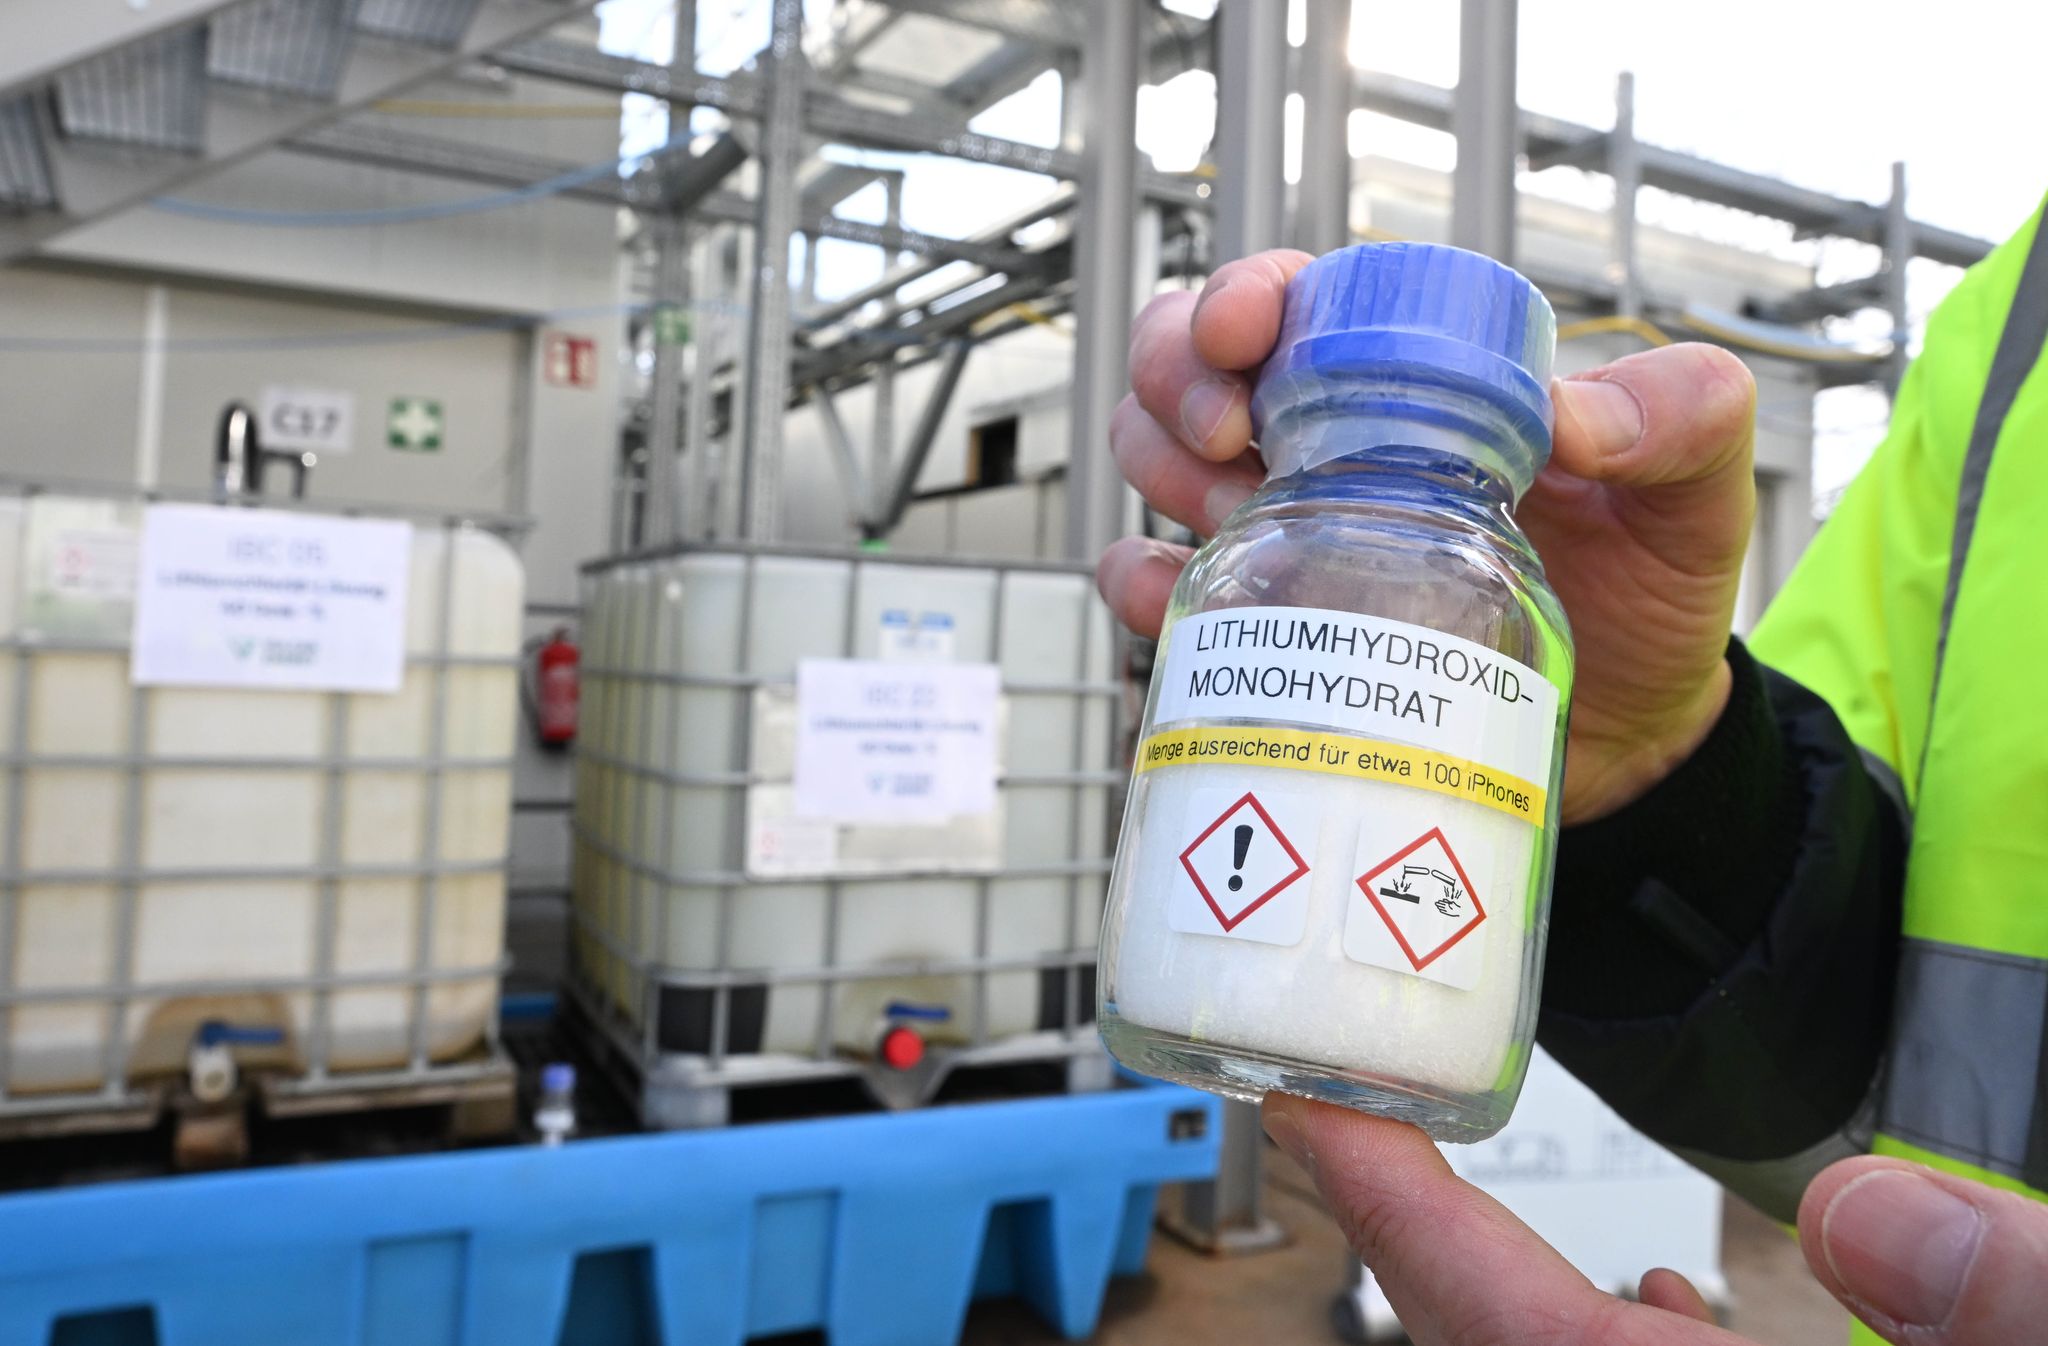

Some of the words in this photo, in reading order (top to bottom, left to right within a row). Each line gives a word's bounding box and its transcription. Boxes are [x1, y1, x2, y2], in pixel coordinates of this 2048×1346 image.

[270, 402, 341, 438] C17
[1197, 619, 1534, 704] LITHIUMHYDROXID-
[1188, 666, 1453, 727] MONOHYDRAT
[1146, 741, 1184, 763] Menge
[1187, 737, 1311, 762] ausreichend
[1319, 743, 1350, 765] für
[1357, 751, 1411, 777] etwa
[1423, 760, 1461, 788] 100
[1467, 771, 1530, 813] iPhones
